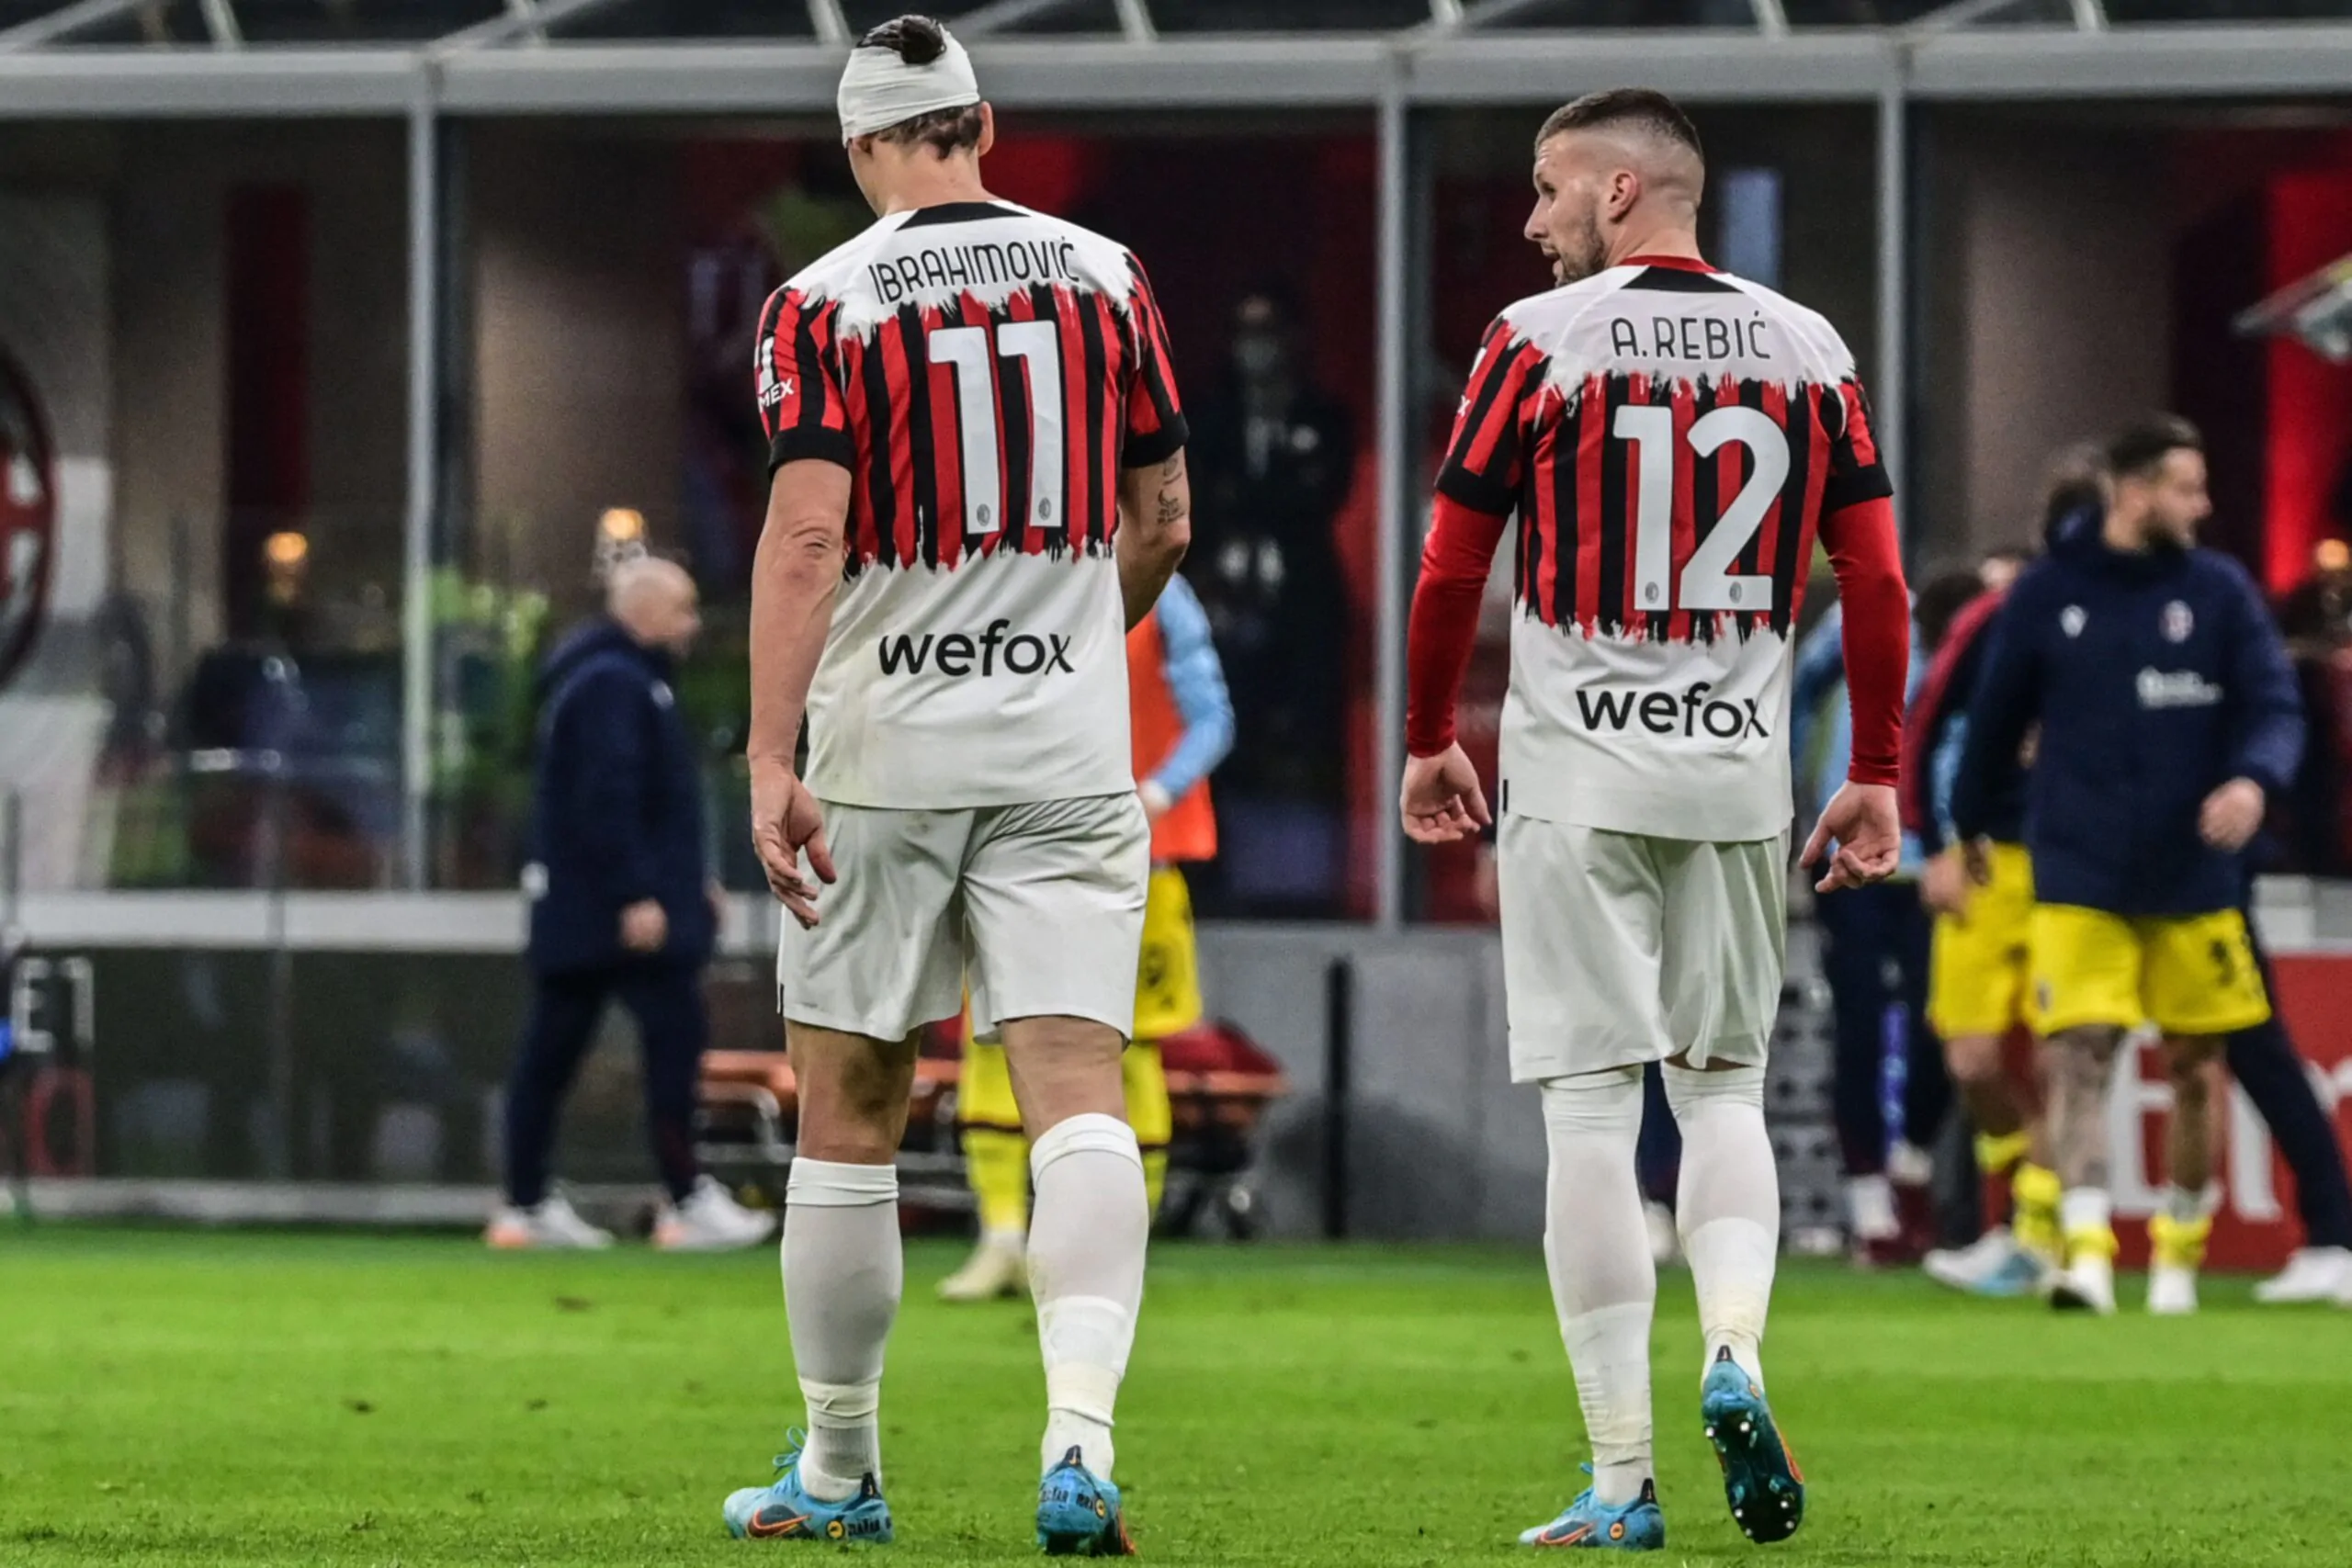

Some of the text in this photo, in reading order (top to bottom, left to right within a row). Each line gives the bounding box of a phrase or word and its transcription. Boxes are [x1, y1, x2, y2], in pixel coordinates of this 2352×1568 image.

[868, 236, 1080, 304] IBRAHIMOVIĆ
[1611, 310, 1770, 360] A.REBIĆ
[928, 320, 1063, 535] 11
[1613, 404, 1791, 611] 12
[878, 618, 1075, 677] wefox
[1576, 682, 1770, 739] wefox
